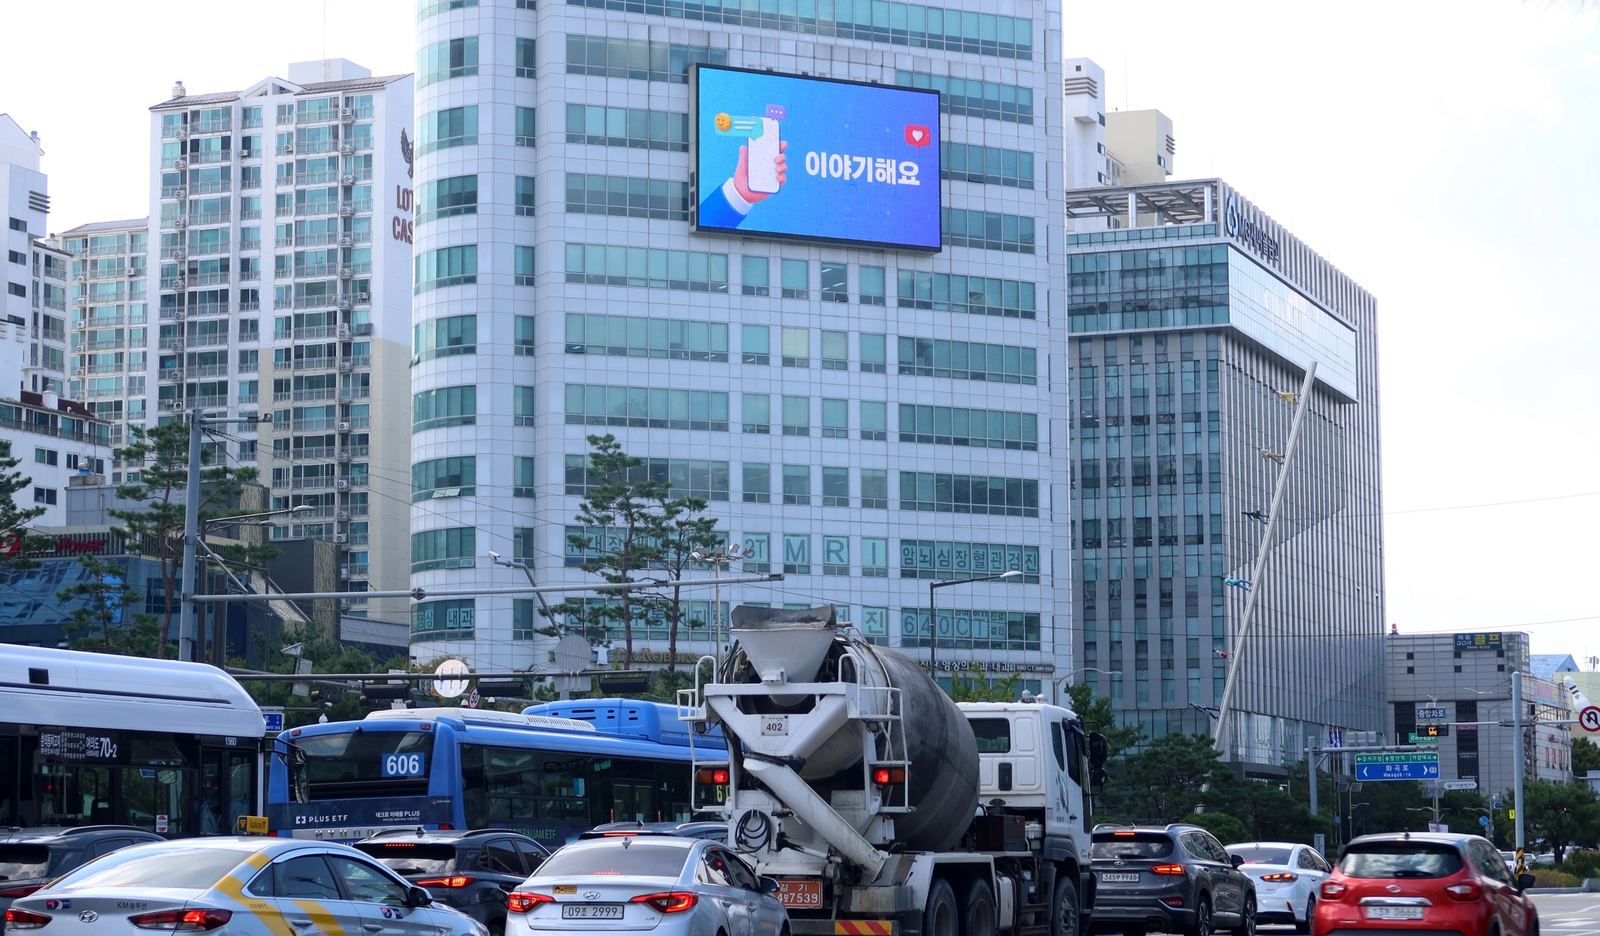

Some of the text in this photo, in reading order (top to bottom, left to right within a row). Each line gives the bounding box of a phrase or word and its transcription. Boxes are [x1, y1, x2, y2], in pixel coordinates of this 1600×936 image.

[805, 151, 921, 186] 이야기해요
[744, 538, 877, 566] 3T MRI
[902, 546, 1038, 573] 암뇌심장혈관검진
[448, 608, 474, 627] 내과
[903, 614, 986, 637] 640CT
[1474, 633, 1500, 645] 골프
[1418, 708, 1445, 719] 중앙차로
[766, 722, 783, 732] 402
[99, 737, 117, 758] 70-2
[386, 754, 419, 775] 606
[1385, 764, 1409, 772] 화곡로
[308, 814, 348, 823] PLUS ETF
[775, 893, 818, 903] 4보7539
[568, 906, 618, 917] 09조 2999
